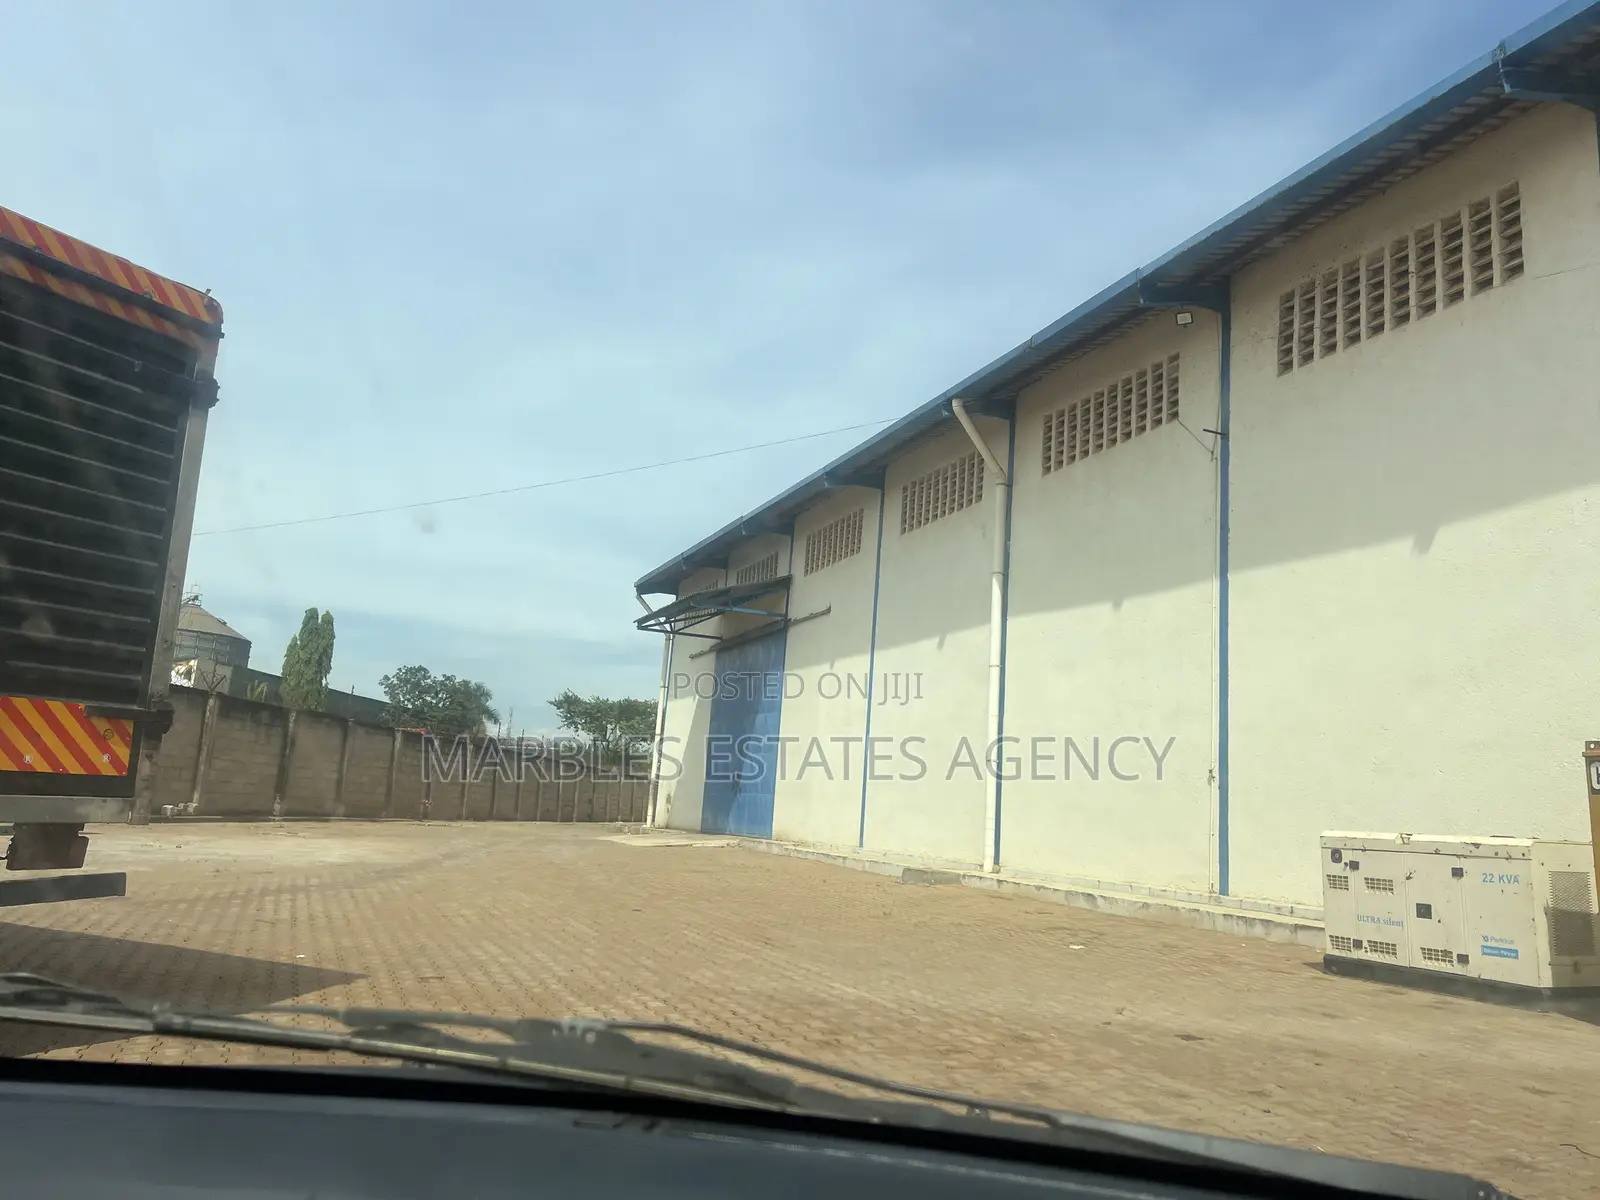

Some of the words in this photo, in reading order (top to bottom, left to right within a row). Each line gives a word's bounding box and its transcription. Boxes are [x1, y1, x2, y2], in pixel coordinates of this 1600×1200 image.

[1482, 872, 1495, 884] 22
[1498, 873, 1520, 885] KVA
[1357, 914, 1381, 925] ULTRA
